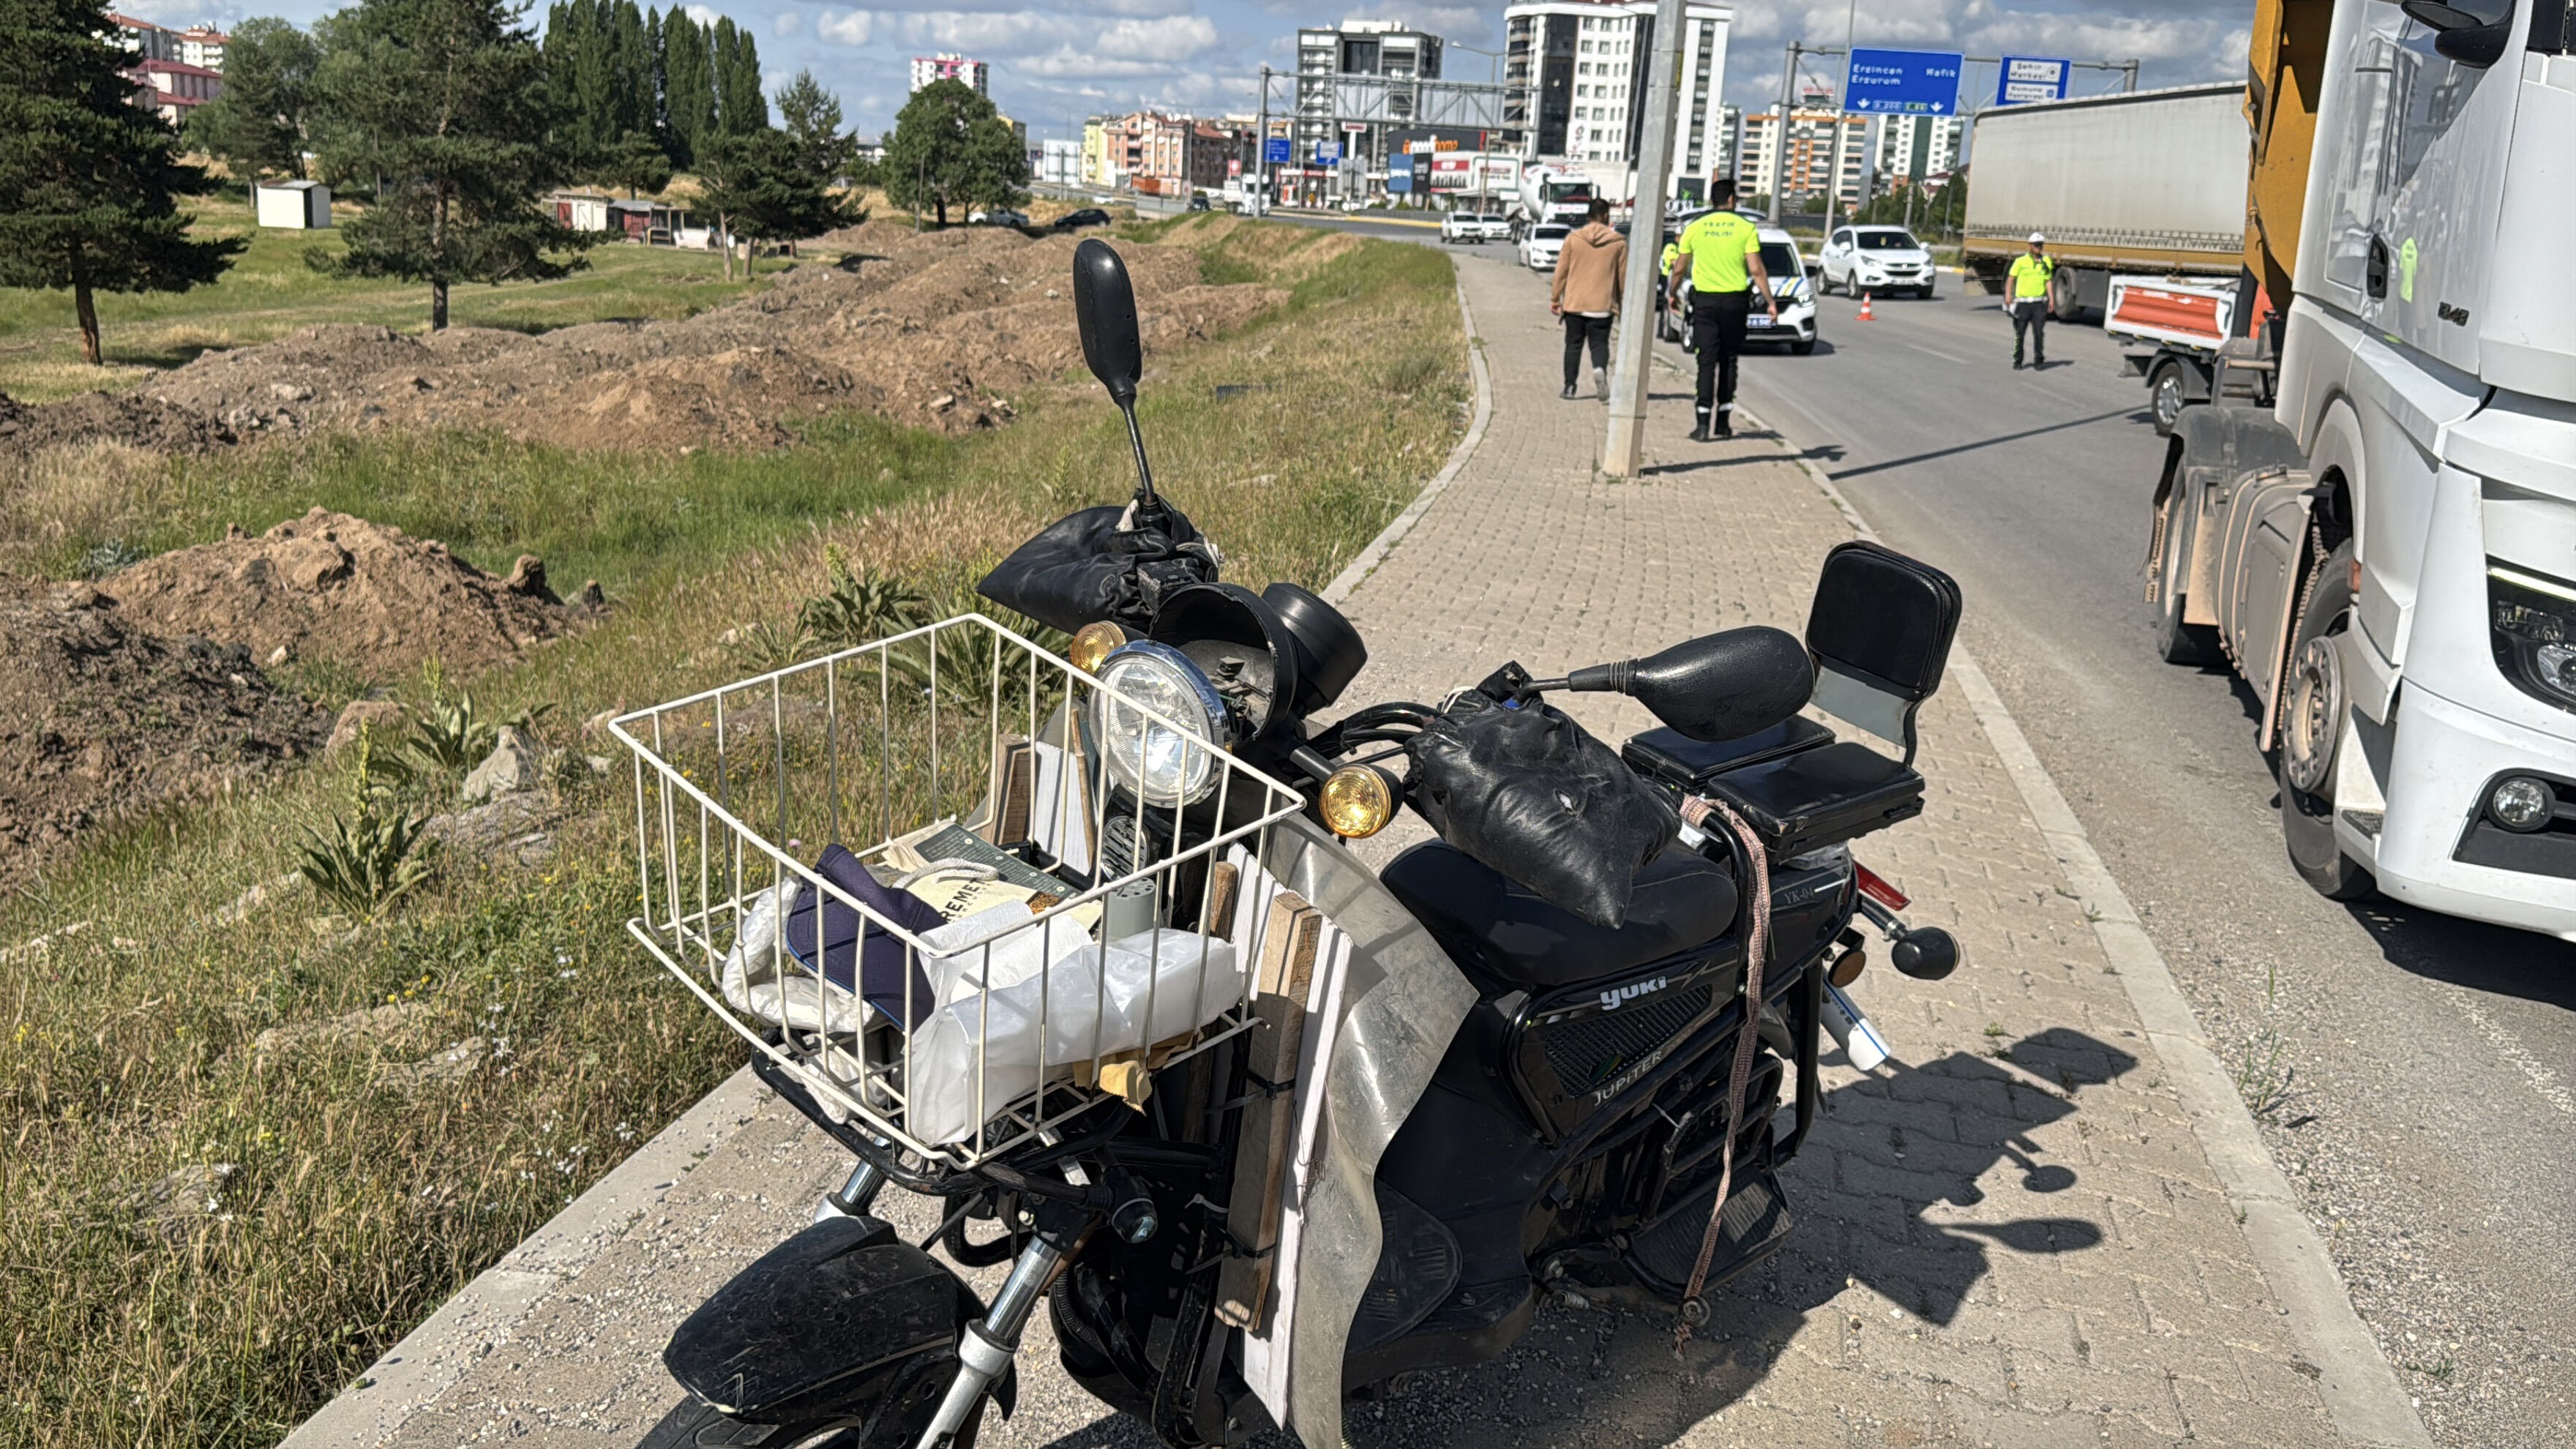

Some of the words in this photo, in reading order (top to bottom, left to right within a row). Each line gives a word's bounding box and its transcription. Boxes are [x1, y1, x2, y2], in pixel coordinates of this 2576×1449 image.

[1852, 63, 1903, 75] Erzincan
[1925, 67, 1956, 78] Hafik
[1852, 74, 1901, 85] Erzurum
